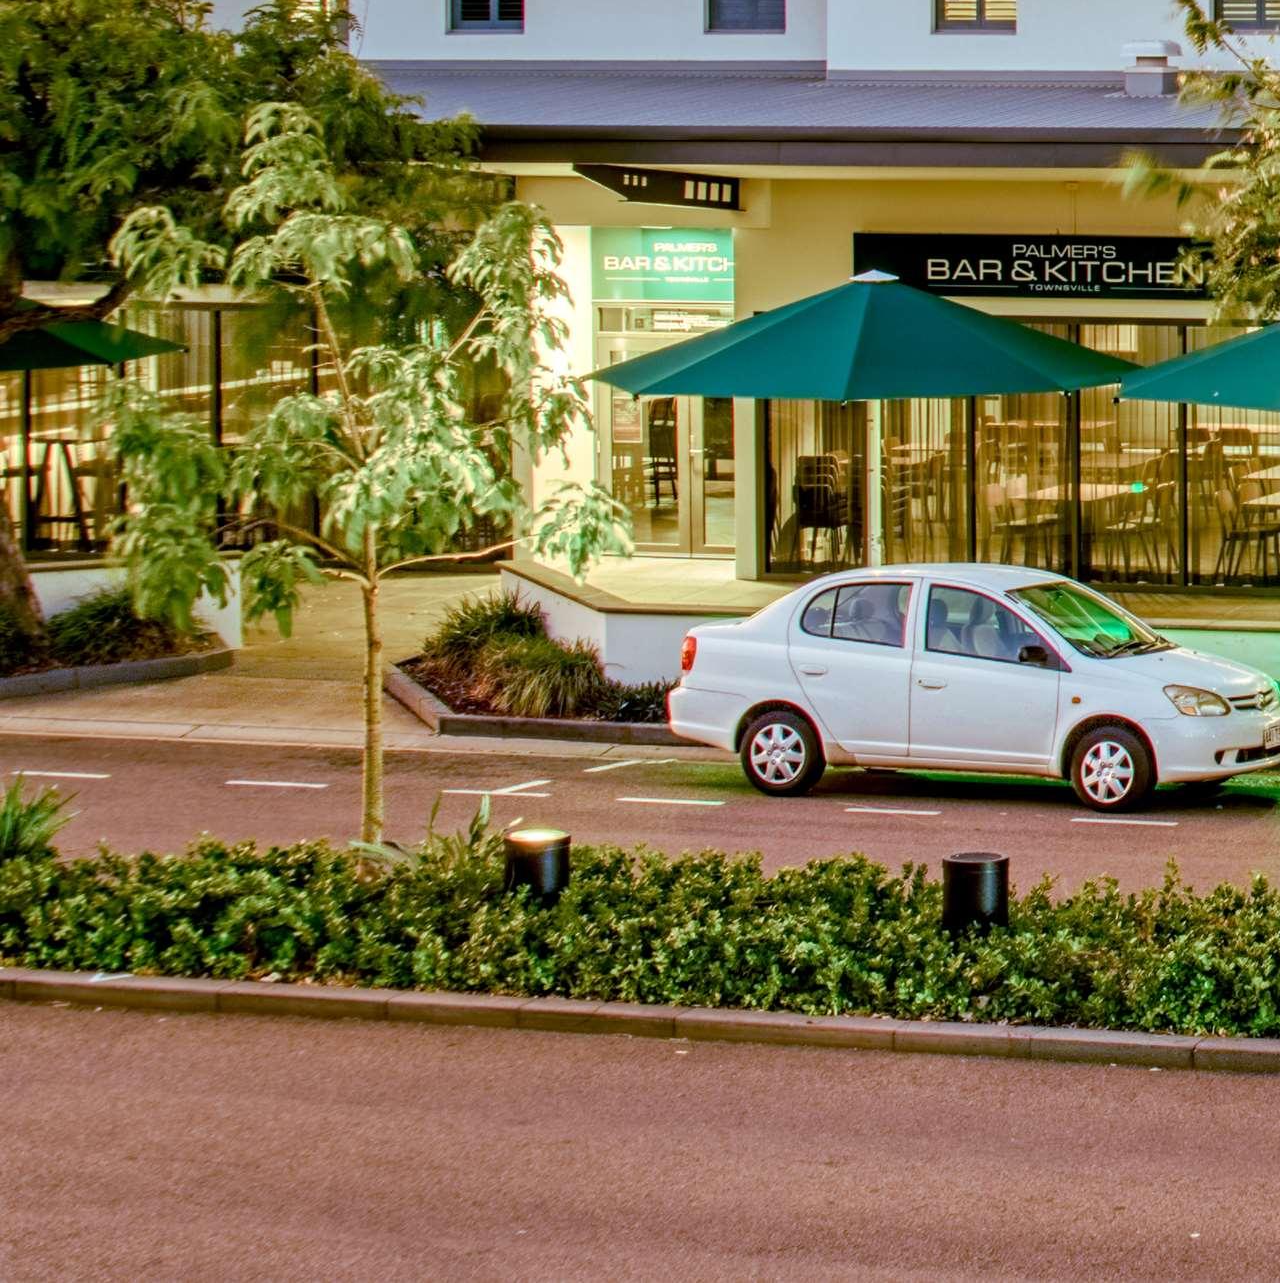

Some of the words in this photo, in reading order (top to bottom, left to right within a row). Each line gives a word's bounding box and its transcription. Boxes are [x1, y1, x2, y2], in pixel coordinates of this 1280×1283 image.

[1012, 244, 1117, 259] PALMER'S
[604, 256, 650, 271] BAR
[653, 256, 672, 271] &
[673, 256, 734, 272] KITCH
[927, 258, 1002, 281] BAR
[1011, 260, 1038, 282] &
[1044, 261, 1204, 285] KITCHEN
[1028, 283, 1101, 292] TOWNSVILLE
